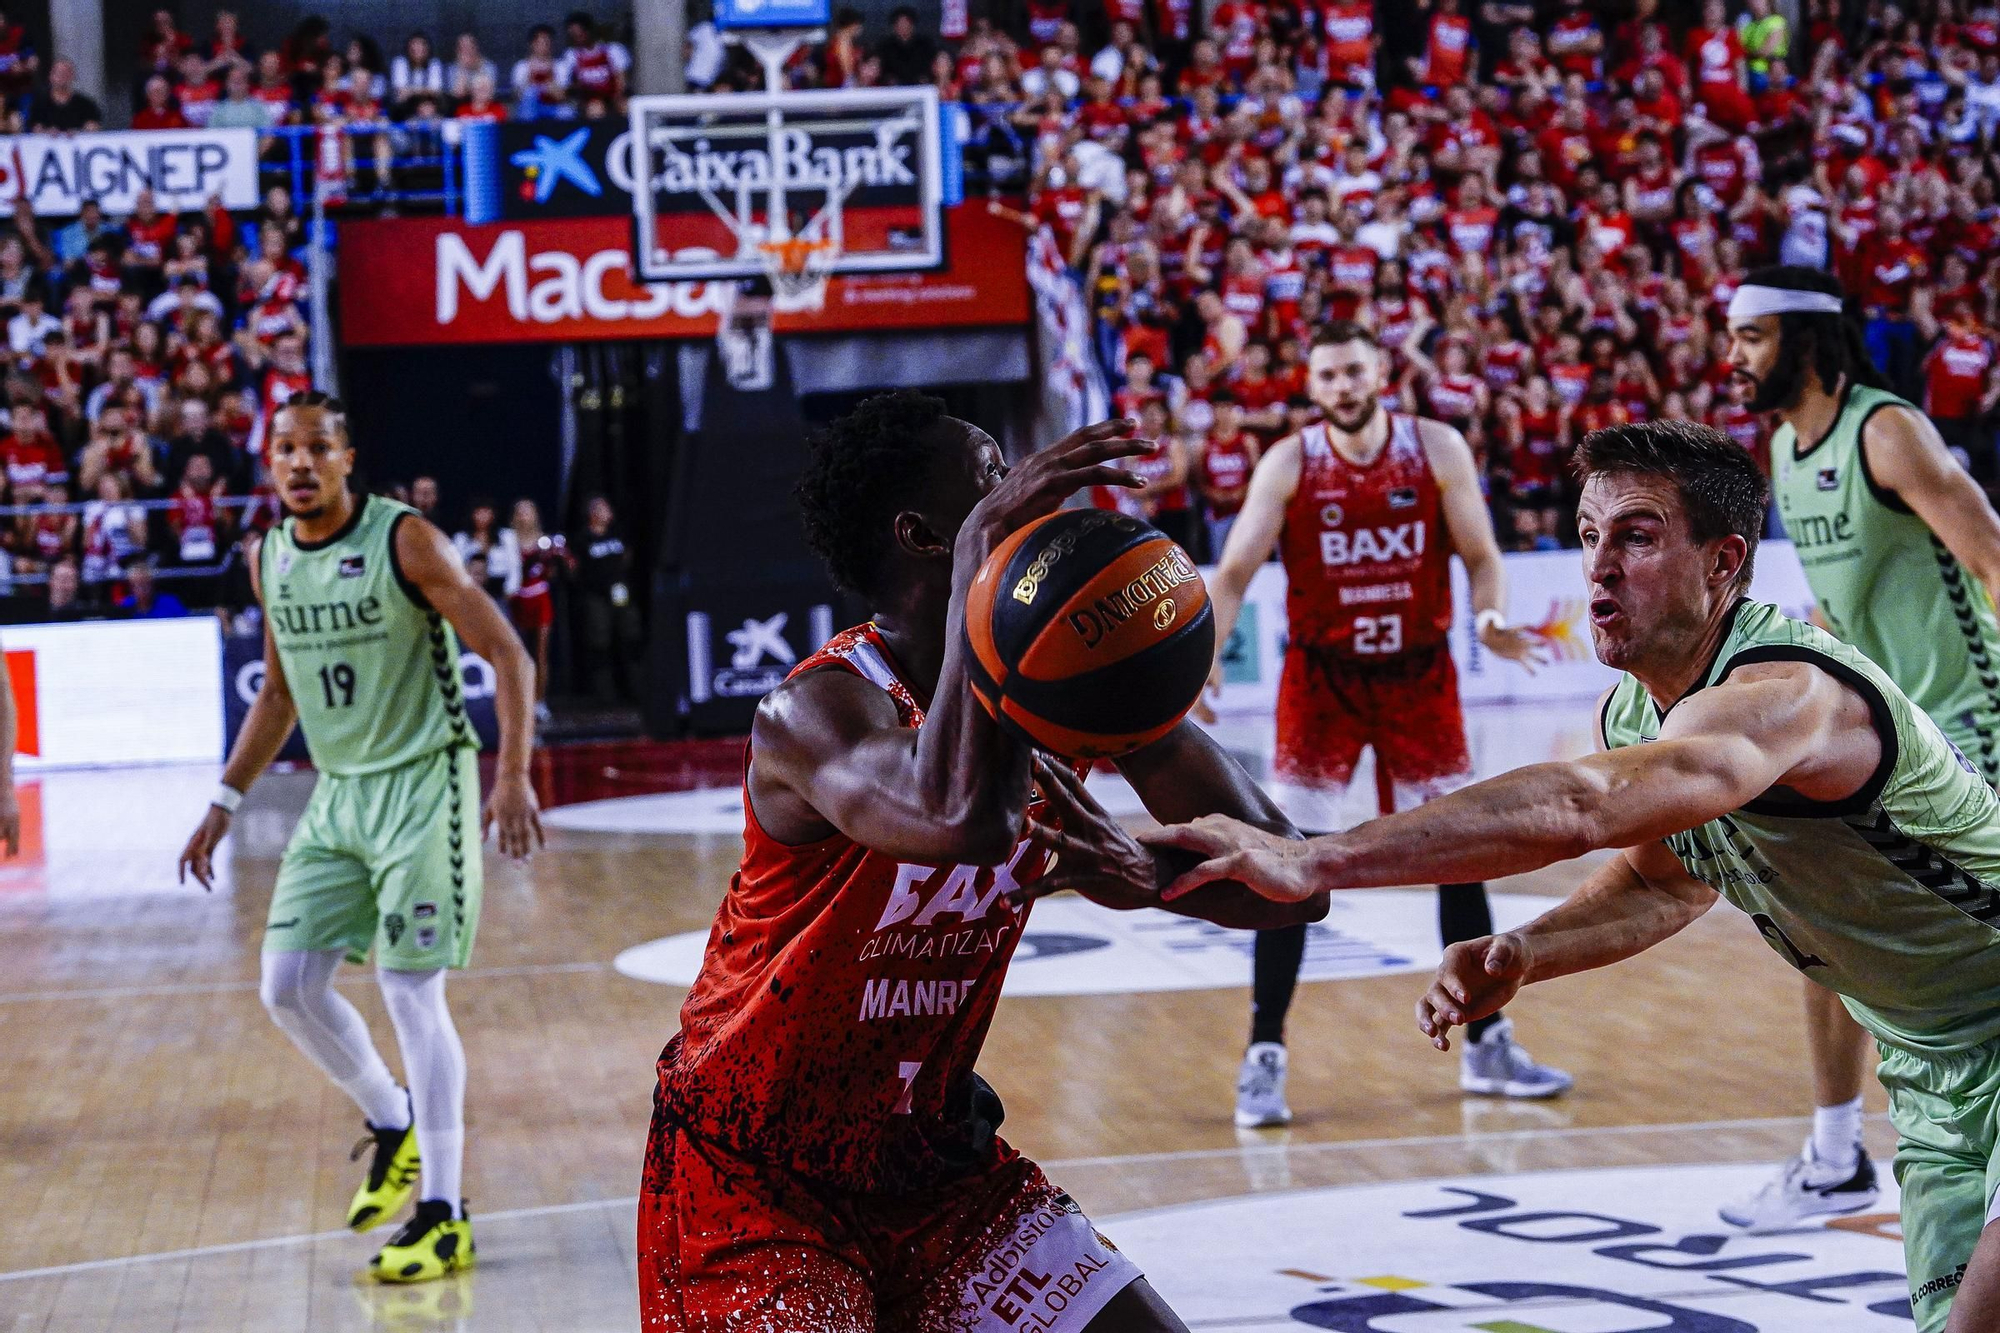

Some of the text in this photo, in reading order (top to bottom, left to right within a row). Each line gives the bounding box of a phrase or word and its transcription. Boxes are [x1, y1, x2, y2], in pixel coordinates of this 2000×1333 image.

[33, 143, 229, 200] AIGNEP
[604, 122, 917, 193] CaixaBank
[1319, 520, 1426, 565] BAXI
[272, 595, 383, 634] surne
[1353, 614, 1402, 654] 23
[318, 662, 356, 709] 19
[990, 1266, 1053, 1326] ETL
[1018, 1253, 1110, 1333] GLOBAL
[1911, 1271, 1965, 1307] EL CORREO
